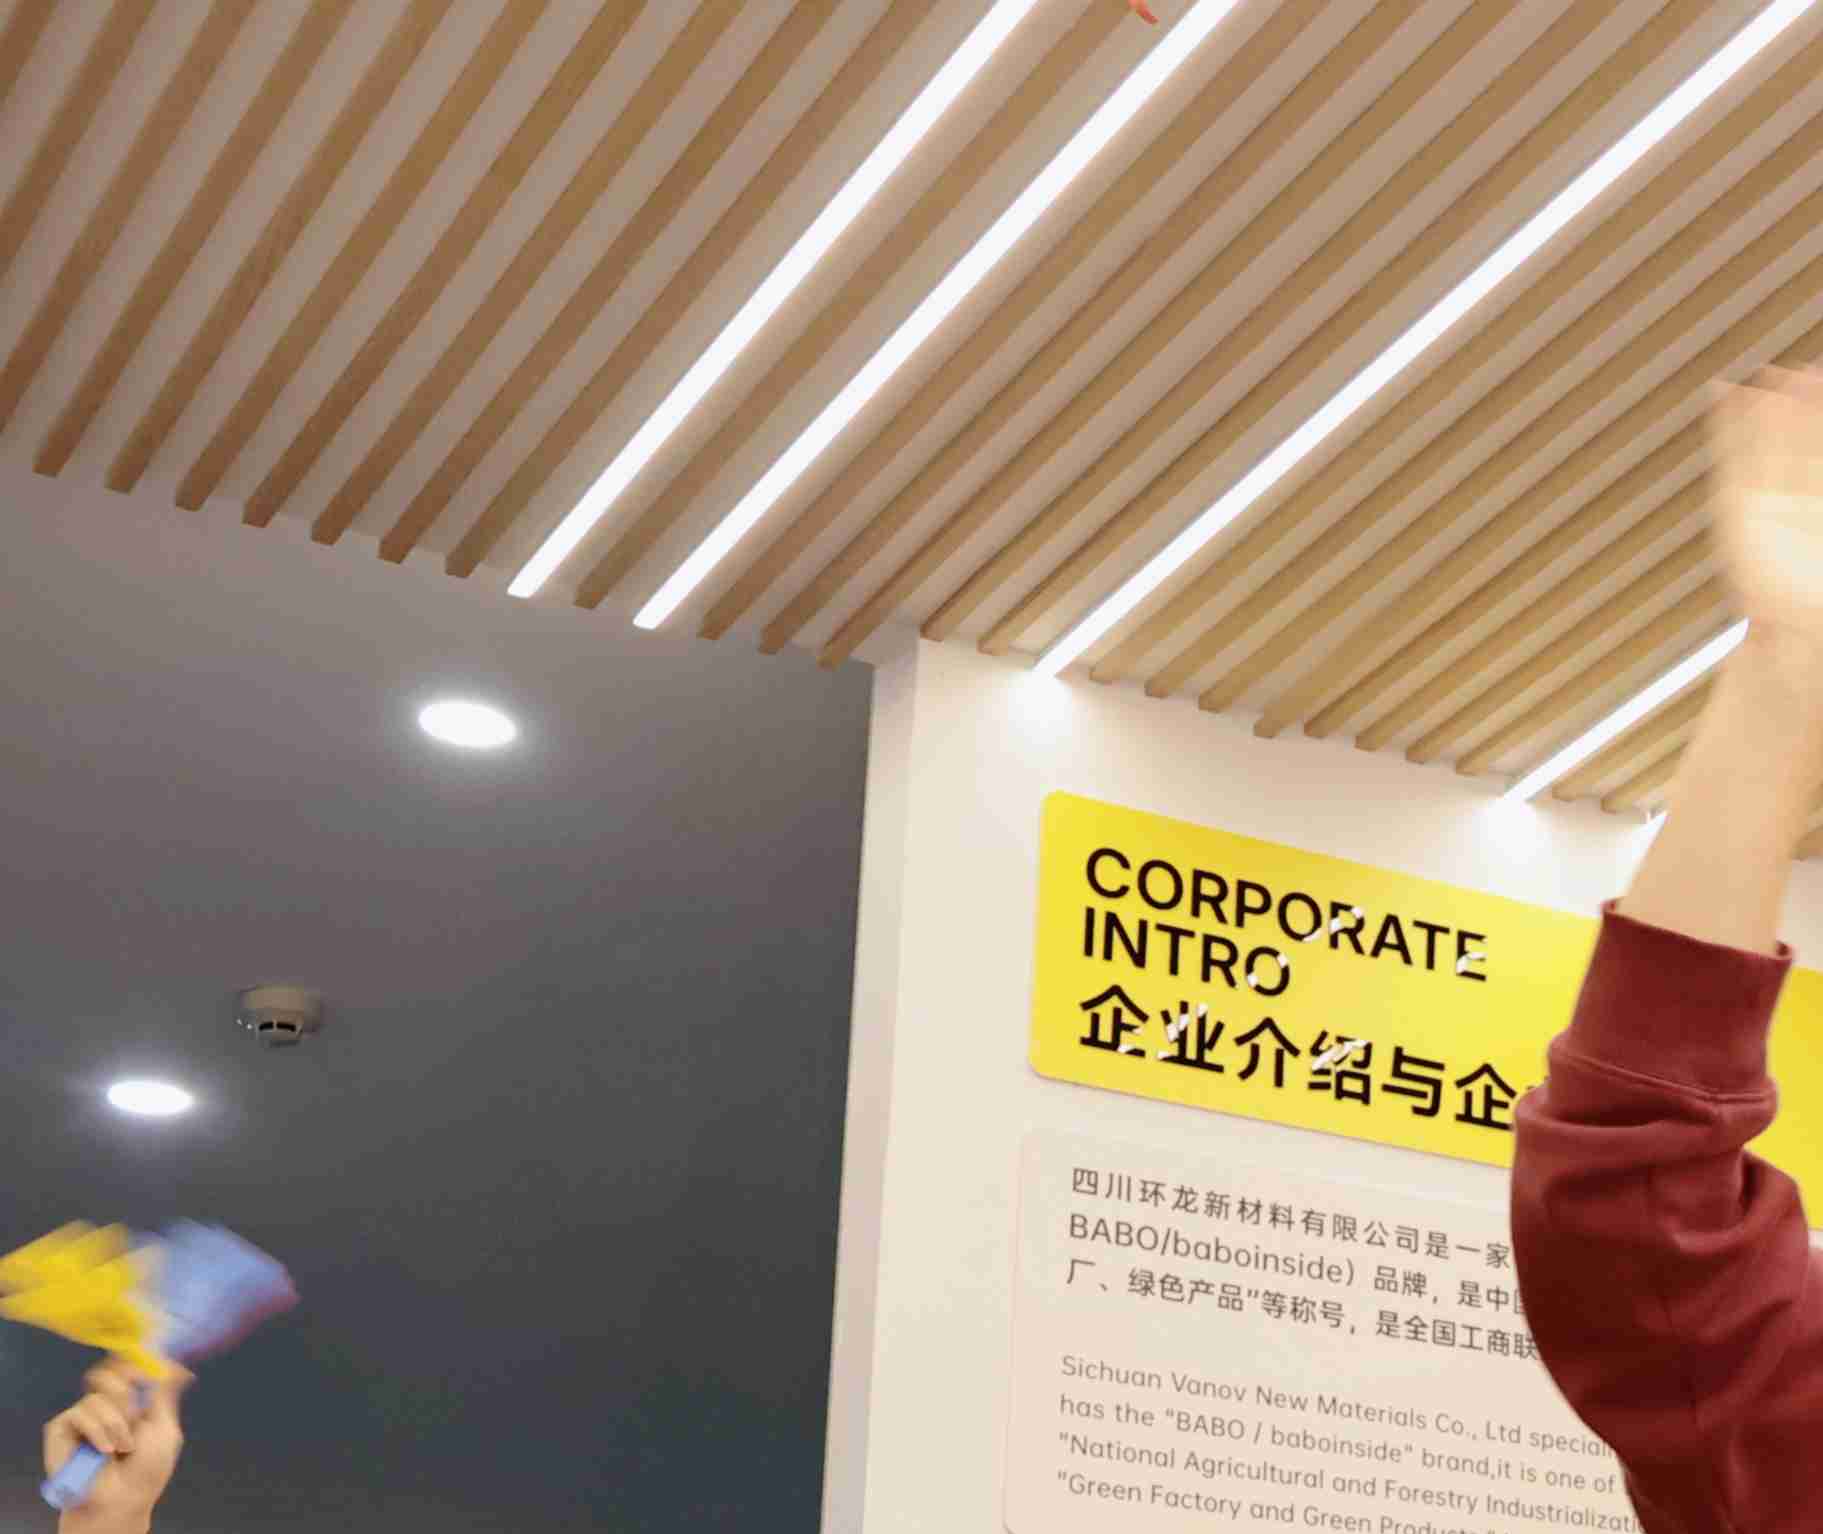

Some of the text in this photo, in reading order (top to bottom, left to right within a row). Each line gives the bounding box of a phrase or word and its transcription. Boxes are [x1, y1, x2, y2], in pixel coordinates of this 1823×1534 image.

[1083, 906, 1291, 997] INTRO
[1086, 847, 1488, 982] CORPORATE
[1071, 1167, 1510, 1270] 四川环龙新材料有限公司是一家
[1059, 1394, 1105, 1420] has
[1115, 1403, 1155, 1427] the
[1519, 1463, 1538, 1484] is
[1544, 1469, 1586, 1491] one
[1593, 1474, 1617, 1494] of
[1061, 1355, 1162, 1390] Sichuan
[1171, 1371, 1248, 1402] Vanov
[1255, 1384, 1309, 1413] New
[1317, 1393, 1428, 1430] Materials
[1485, 1419, 1522, 1445] Ltd
[1149, 1484, 1242, 1521] Factory
[1249, 1502, 1296, 1524] and
[1302, 1504, 1372, 1534] Green
[1184, 1450, 1325, 1490] Agricultural
[1332, 1476, 1377, 1497] and
[1384, 1480, 1479, 1516] Forestry
